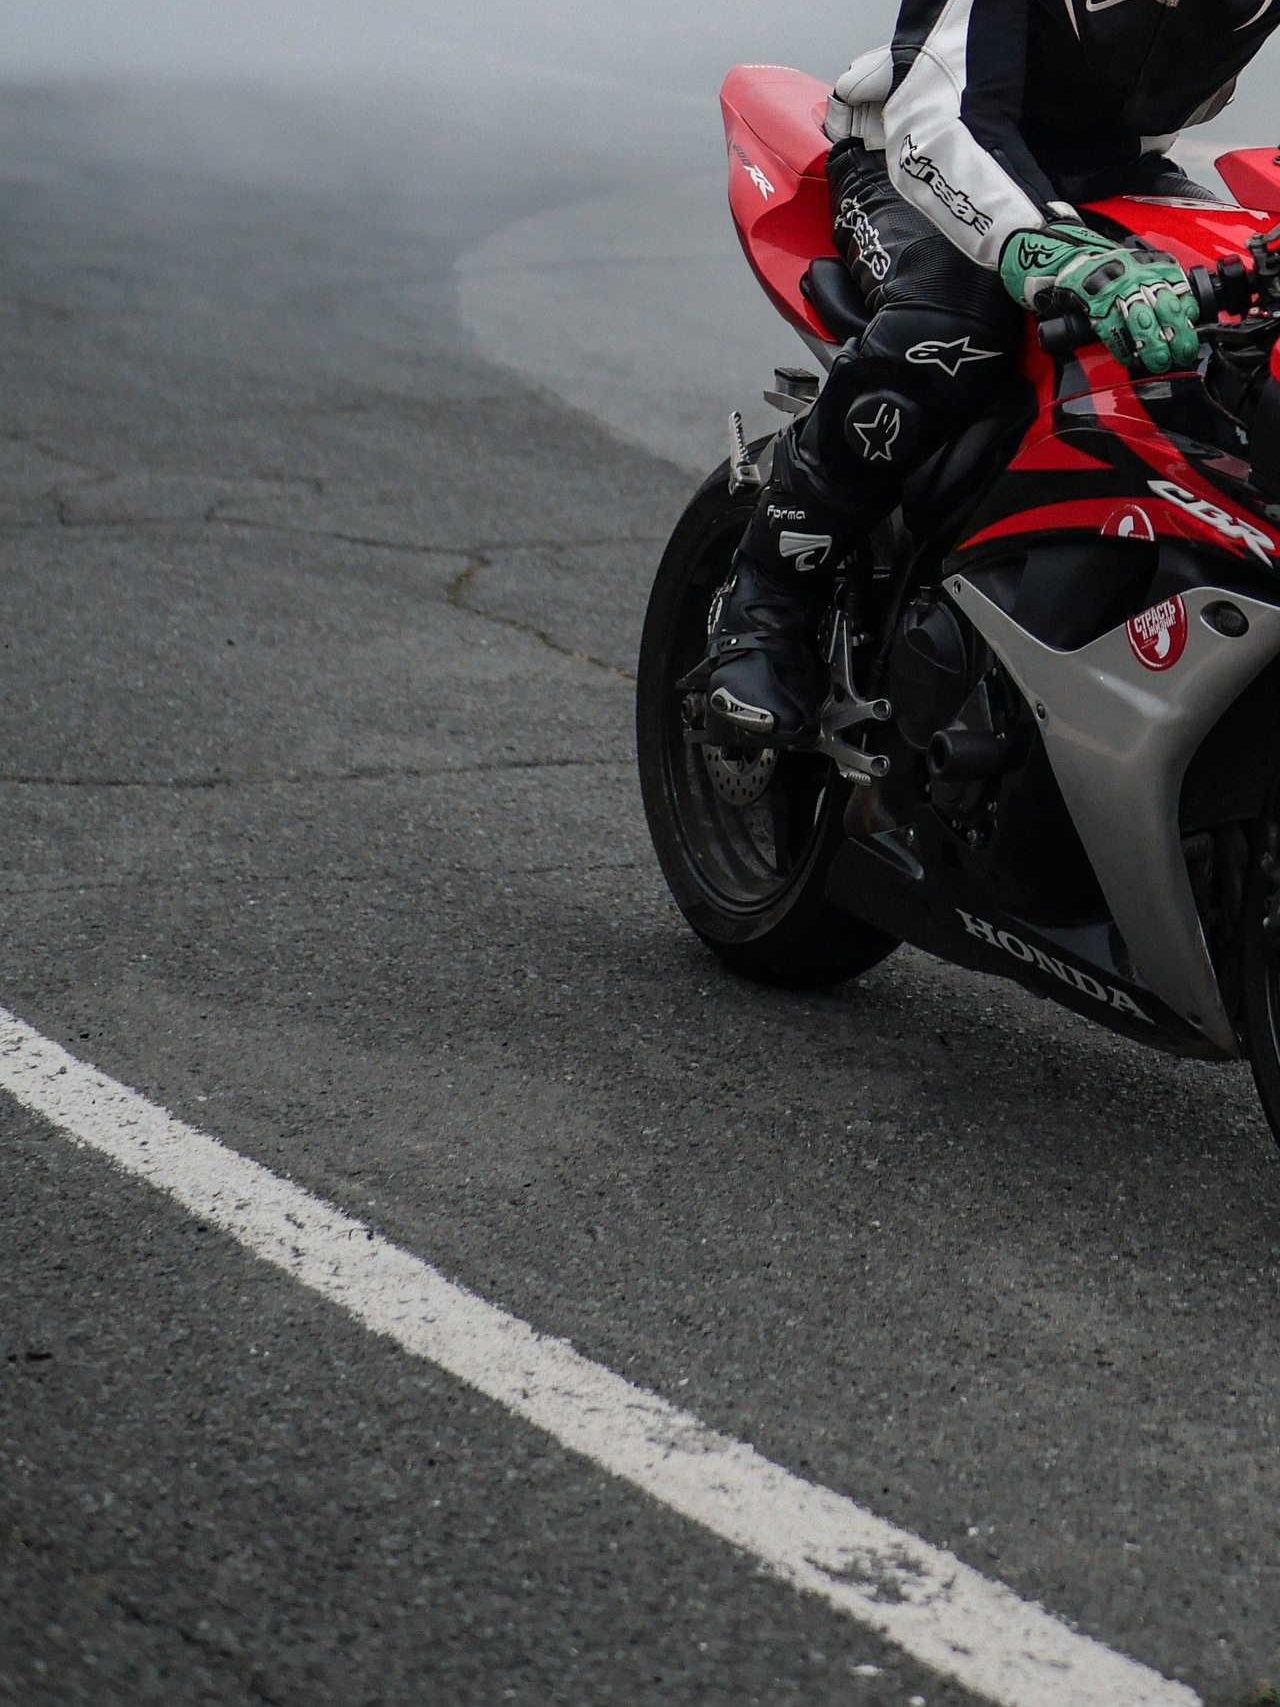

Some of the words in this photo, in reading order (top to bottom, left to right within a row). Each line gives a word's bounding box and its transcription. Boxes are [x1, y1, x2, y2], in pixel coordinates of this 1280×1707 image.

[1147, 480, 1275, 569] CBR
[1133, 600, 1176, 633] СТРАСТЬ
[1148, 615, 1176, 637] ЖИЗНИ!
[956, 908, 1155, 1024] HONDA
